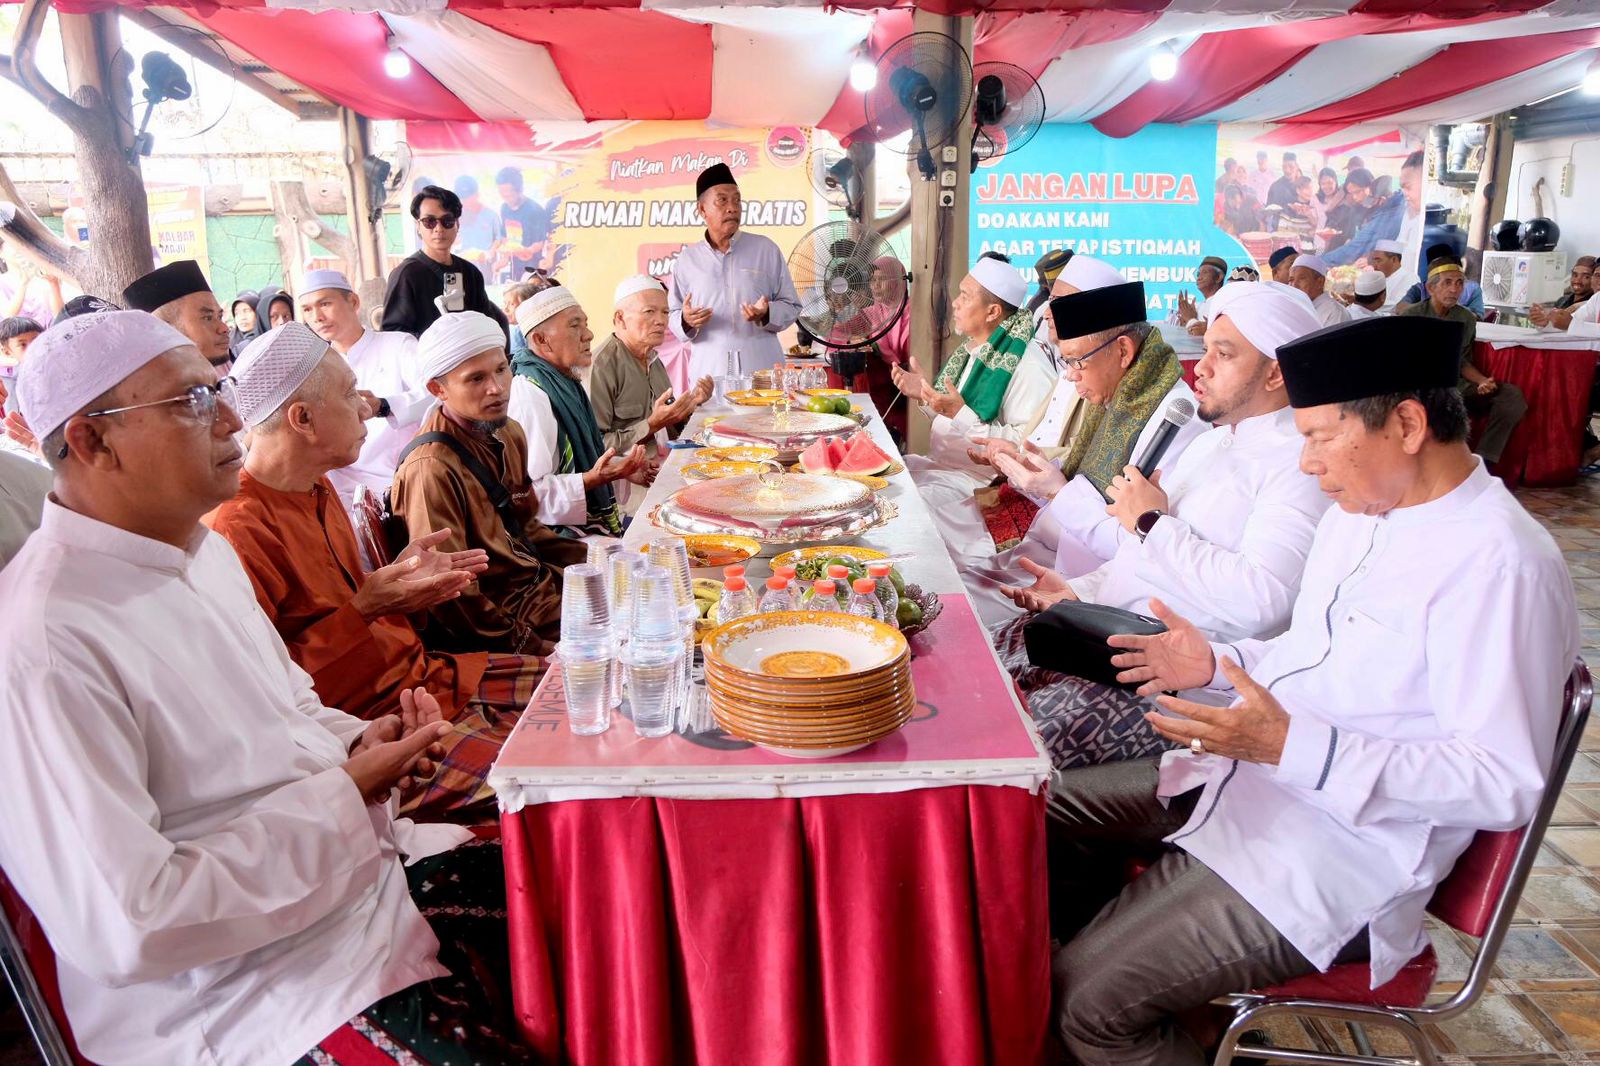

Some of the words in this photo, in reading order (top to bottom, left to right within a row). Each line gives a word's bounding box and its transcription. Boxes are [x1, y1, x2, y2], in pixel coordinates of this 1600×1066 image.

[728, 149, 749, 169] Di
[976, 173, 1107, 201] JANGAN
[1113, 173, 1199, 201] LUPA
[564, 201, 645, 228] RUMAH
[649, 201, 708, 228] MAK
[977, 212, 1060, 229] DOAKAN
[1064, 212, 1110, 228] KAMI
[979, 240, 1035, 256] AGAR
[1101, 240, 1201, 256] ISTIQMAH
[1120, 266, 1196, 283] EMBUK
